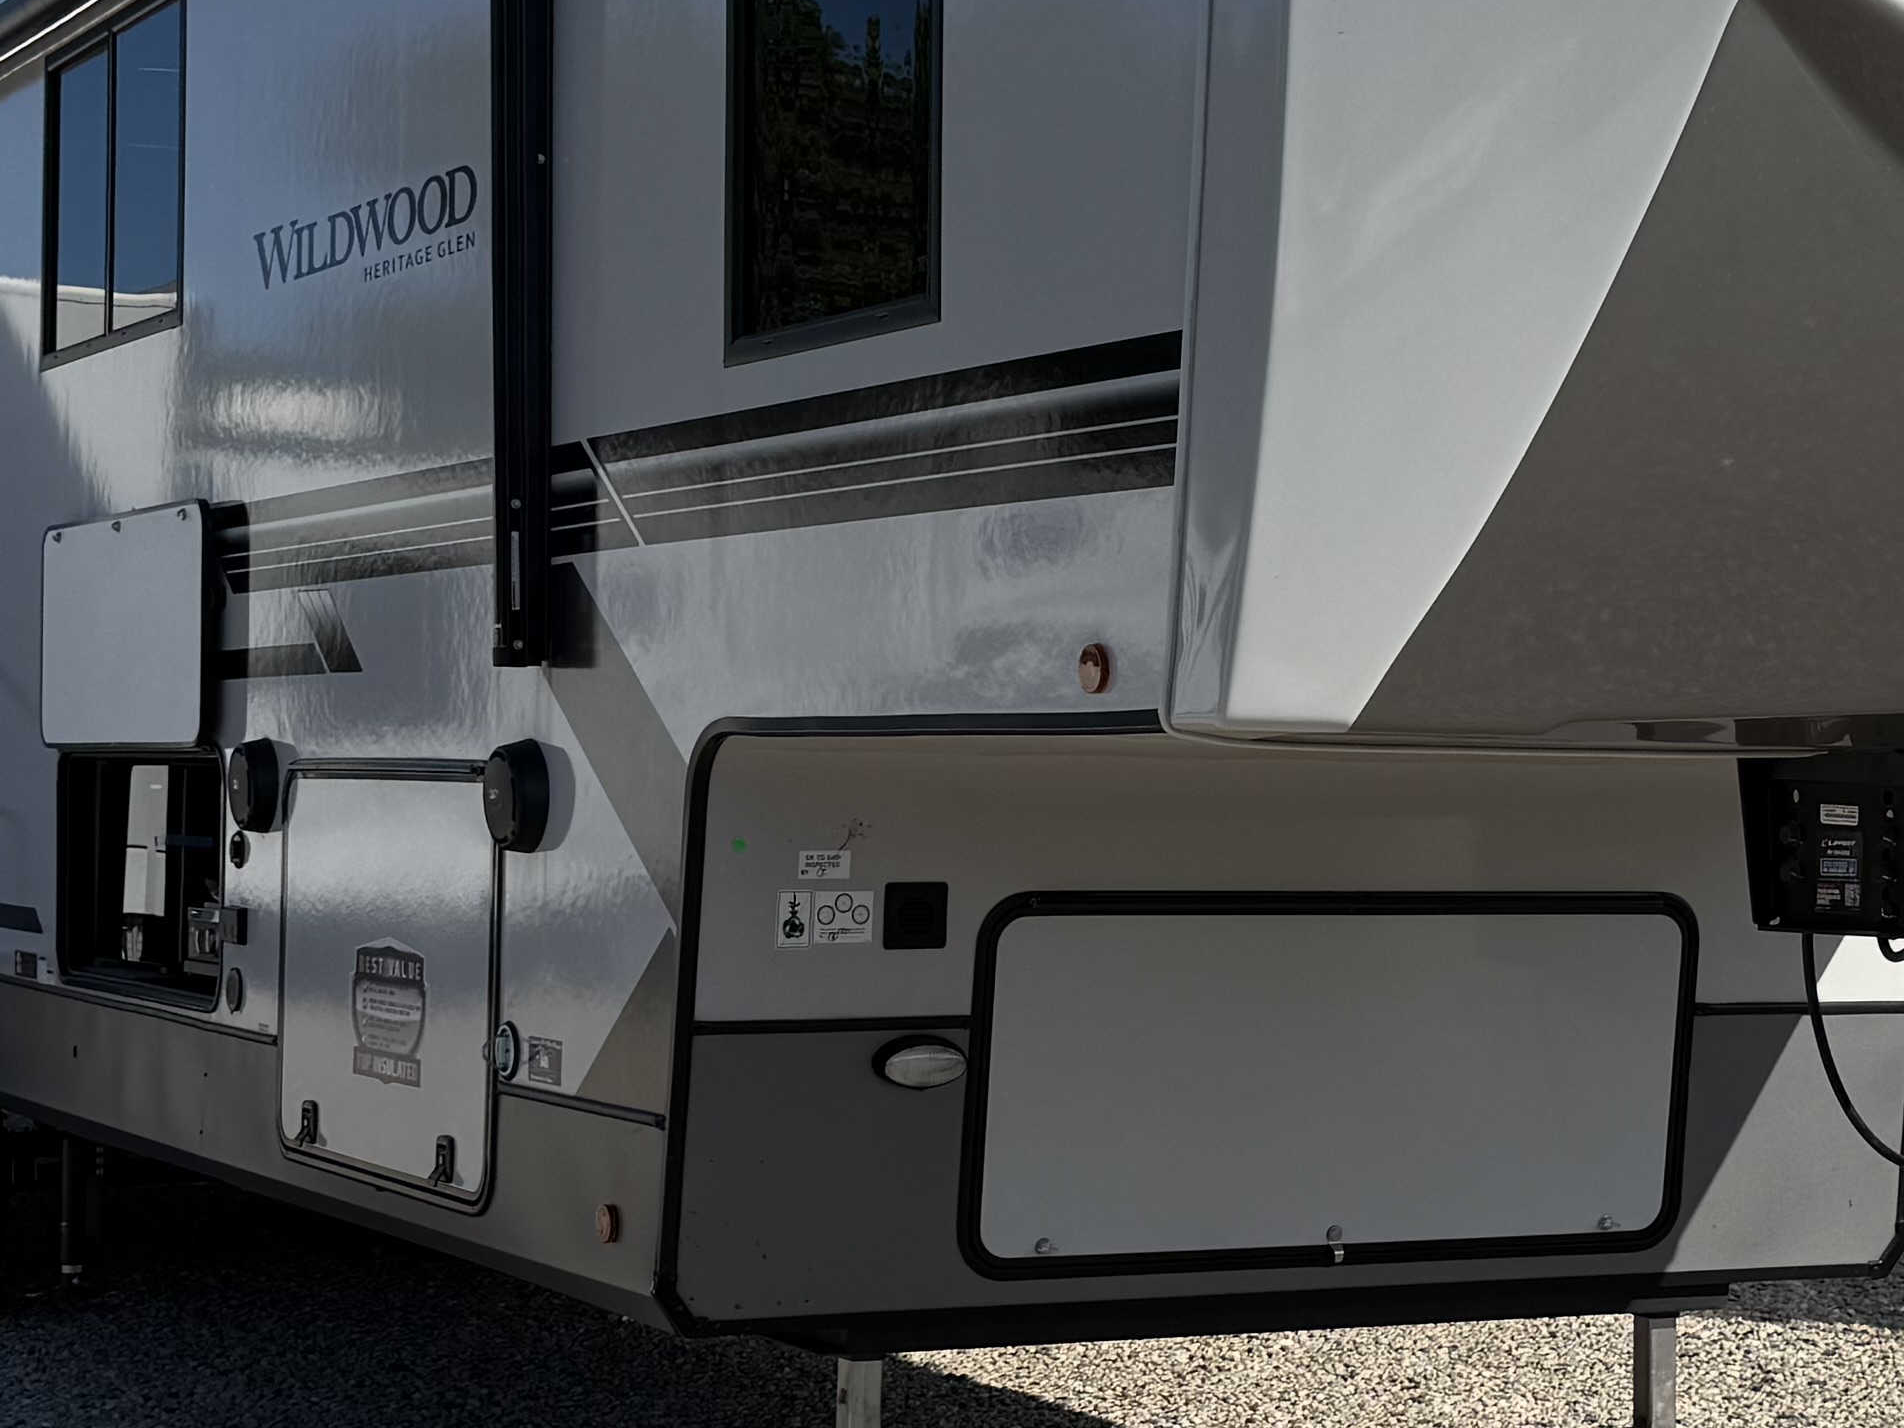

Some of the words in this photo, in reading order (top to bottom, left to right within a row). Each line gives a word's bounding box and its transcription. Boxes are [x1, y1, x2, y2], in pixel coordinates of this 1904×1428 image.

[252, 164, 478, 291] WILDWOOD
[363, 245, 434, 283] HERITAGE
[436, 230, 477, 259] GLEN
[387, 959, 423, 981] VALUE
